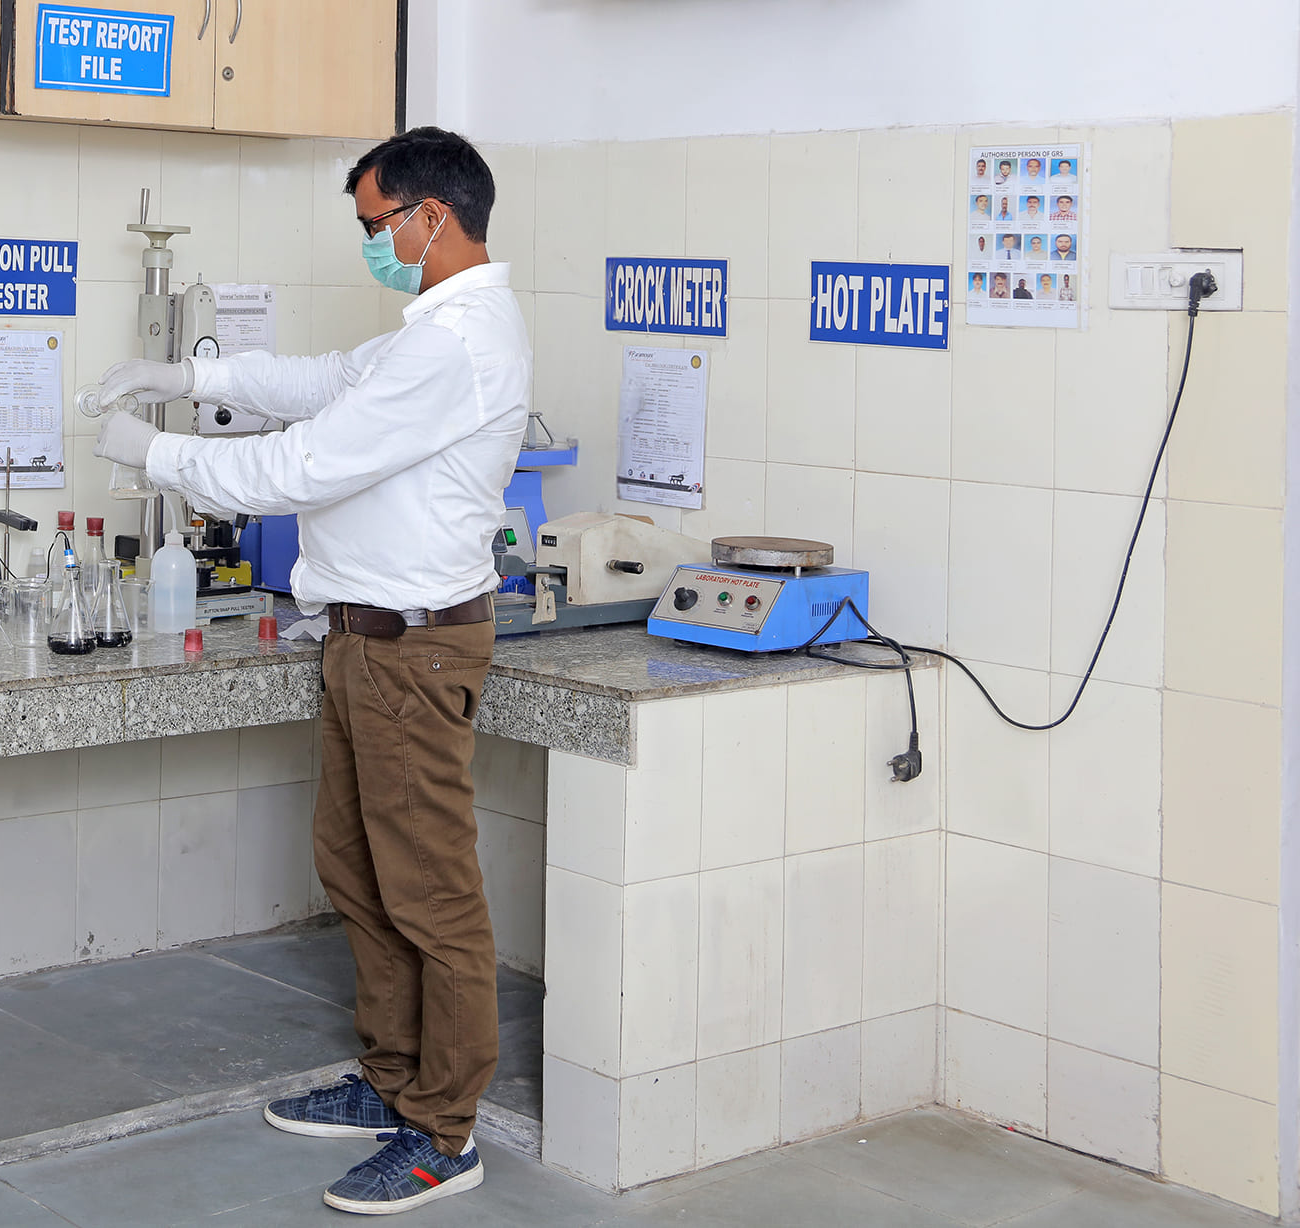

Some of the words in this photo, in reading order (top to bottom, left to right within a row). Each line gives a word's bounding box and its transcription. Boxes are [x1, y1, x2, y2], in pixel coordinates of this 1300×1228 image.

[48, 17, 92, 47] TEST
[96, 21, 163, 52] REPORT
[80, 55, 122, 80] FILE
[29, 245, 73, 273] PULL
[615, 264, 666, 325] CROCK
[669, 266, 722, 328] METER
[816, 274, 864, 331] HOT
[869, 276, 944, 336] PLATE
[696, 574, 731, 584] LABORATORY
